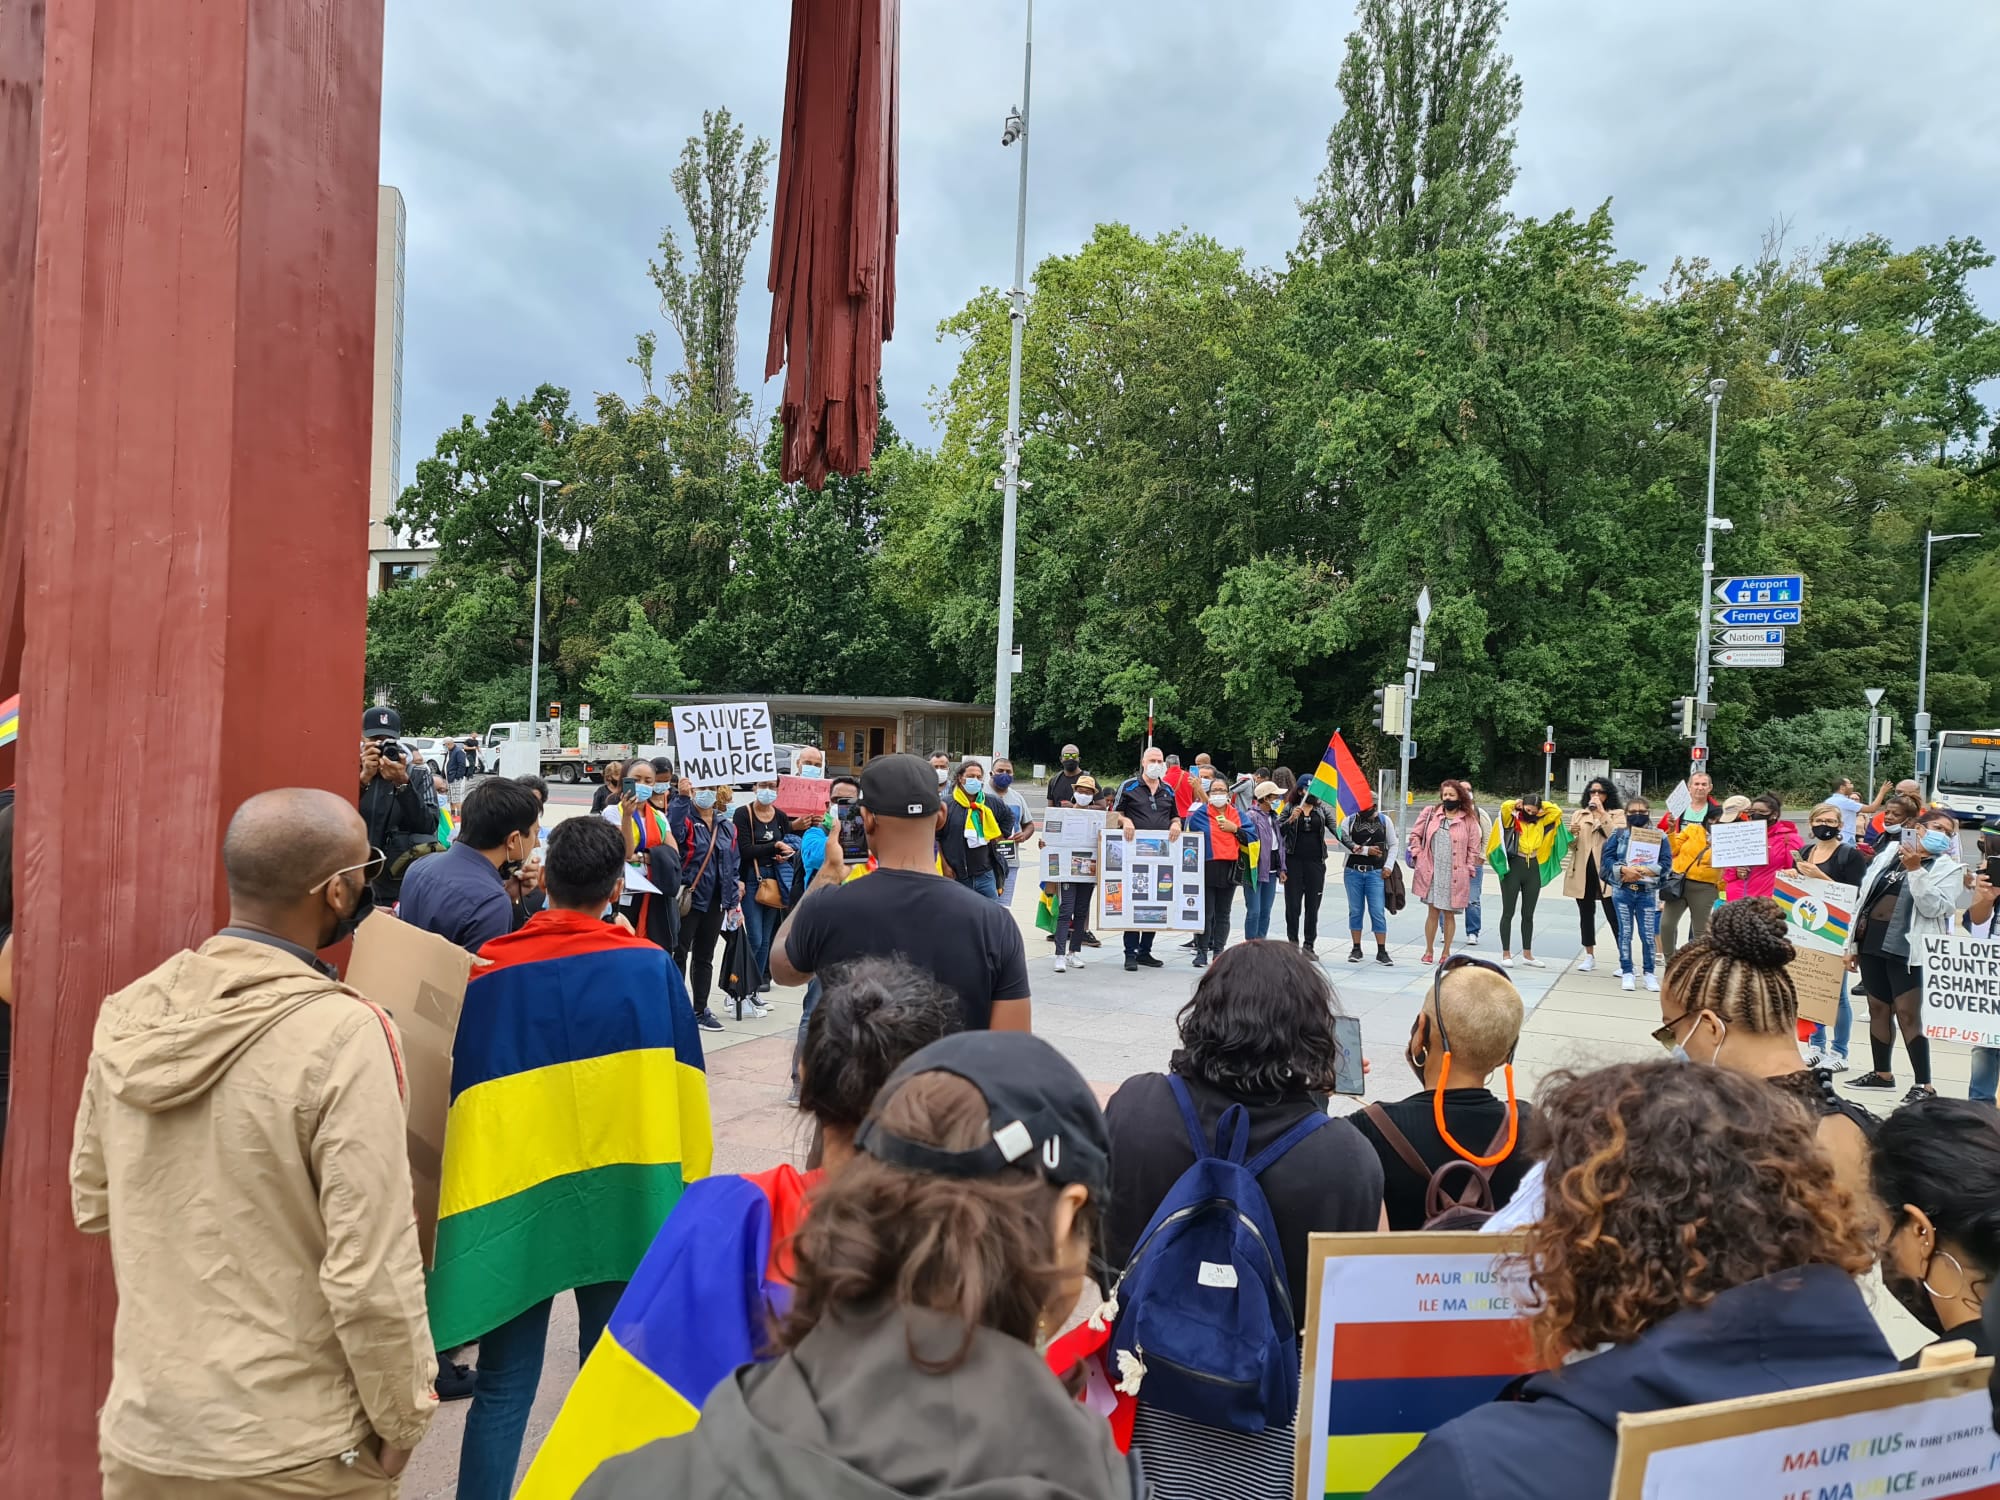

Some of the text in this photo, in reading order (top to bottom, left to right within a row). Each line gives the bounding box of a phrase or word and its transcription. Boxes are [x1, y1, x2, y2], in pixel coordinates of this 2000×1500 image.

[1741, 580, 1788, 589] Aéroport
[1732, 609, 1797, 623] Ferney Gex
[1729, 633, 1765, 642] Nations
[682, 707, 768, 733] SAUVEZ
[684, 752, 774, 780] MAURICE
[1925, 937, 2000, 959] WE LOVE
[1927, 974, 2000, 997] ASHAME
[1415, 1271, 1498, 1285] MAURITIUS
[1418, 1299, 1438, 1312] ILE
[1442, 1297, 1511, 1312] MAURICE
[1781, 1425, 1985, 1473] MAURITIUS IN DIRE STRAITS
[1921, 1475, 1936, 1488] EN
[1938, 1464, 1980, 1485] DANGER
